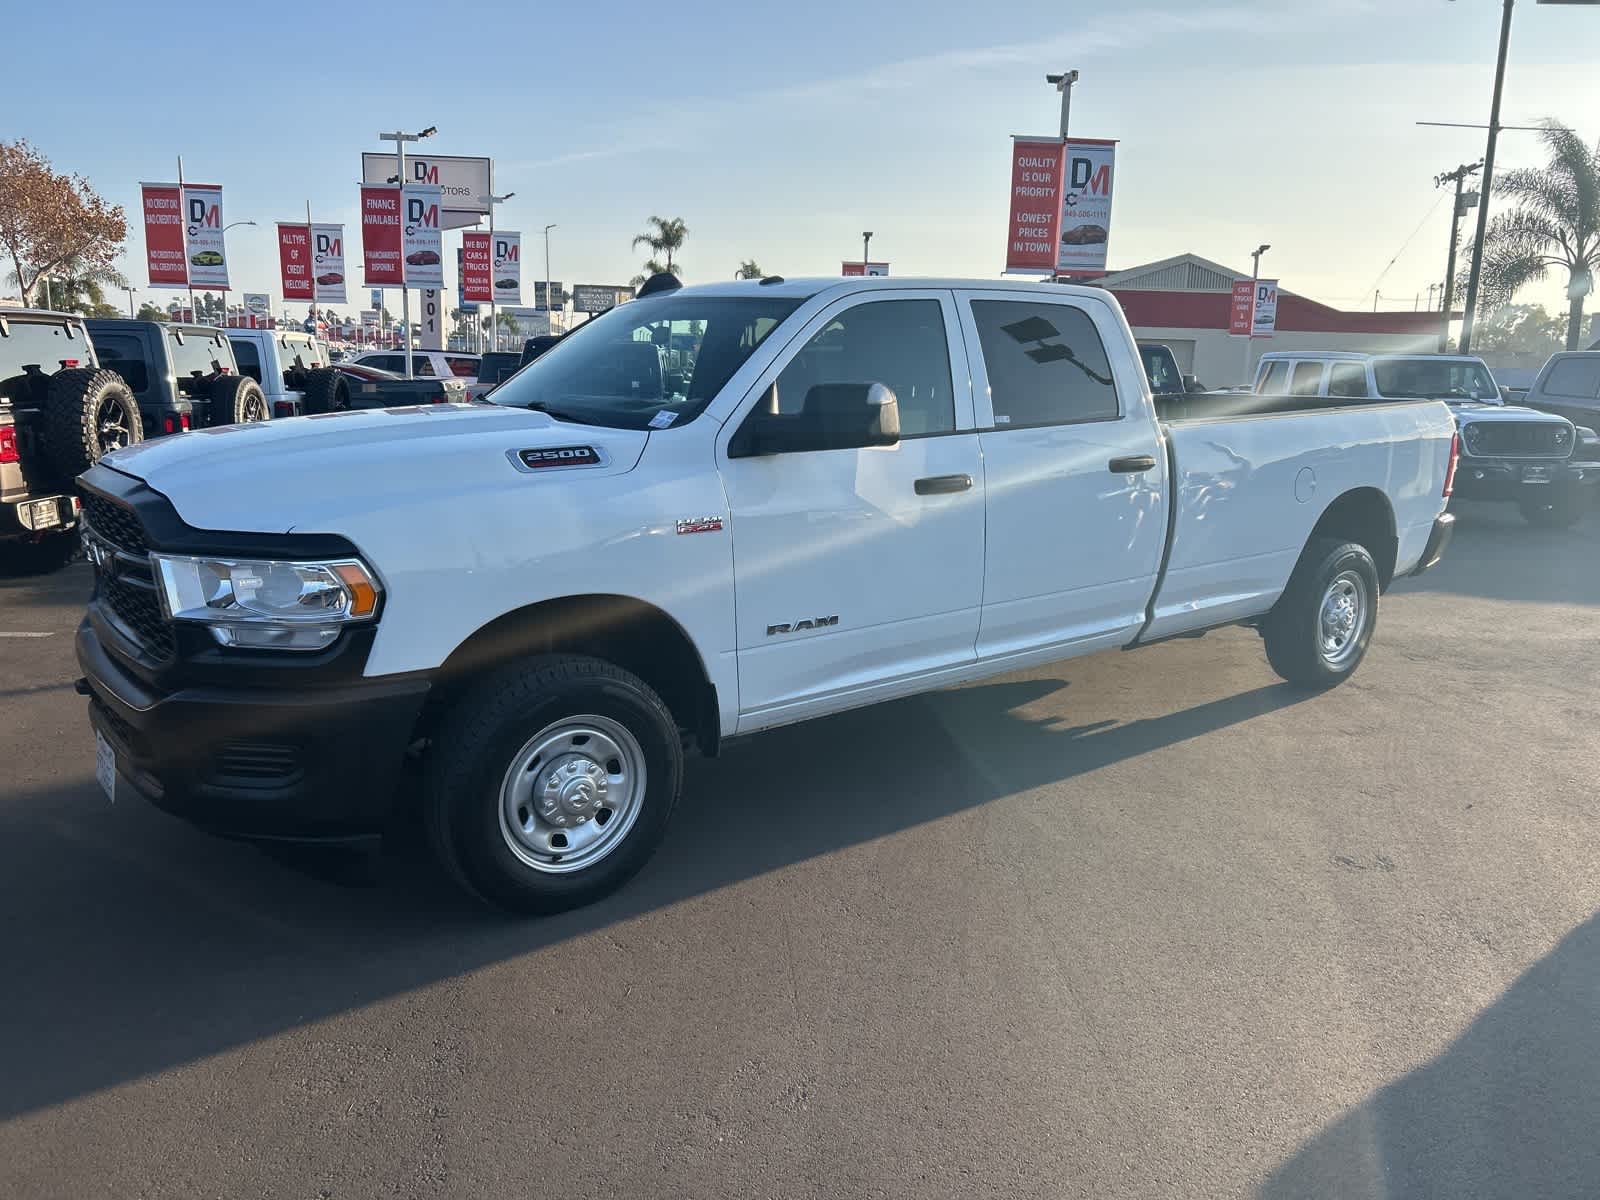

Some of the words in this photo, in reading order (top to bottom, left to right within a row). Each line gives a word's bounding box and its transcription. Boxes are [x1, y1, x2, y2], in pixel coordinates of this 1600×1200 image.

[1018, 157, 1057, 168] QUALITY
[414, 161, 439, 185] DM
[1022, 172, 1031, 182] IS
[1032, 173, 1051, 183] OUR
[1071, 158, 1111, 196] DM
[1015, 187, 1056, 197] PRIORITY
[366, 199, 396, 210] FINANCE
[190, 198, 220, 229] DM
[408, 198, 438, 228] DM
[1017, 213, 1053, 224] LOWEST
[364, 214, 400, 225] AVAILABLE
[1018, 227, 1049, 238] PRICES
[283, 235, 292, 244] ALL
[293, 235, 306, 245] TYPE
[316, 234, 342, 257] DM
[465, 241, 475, 249] WE
[476, 241, 489, 249] BUY
[496, 240, 518, 262] DM
[1014, 242, 1024, 252] IN
[1025, 242, 1052, 253] TOWN
[291, 250, 298, 259] OF
[466, 252, 482, 260] CARS
[287, 265, 304, 274] CREDIT
[465, 263, 489, 271] TRUCKS
[285, 280, 310, 289] WELCOME
[1259, 287, 1275, 303] DM
[527, 449, 590, 461] 2500
[767, 615, 839, 637] RAM
